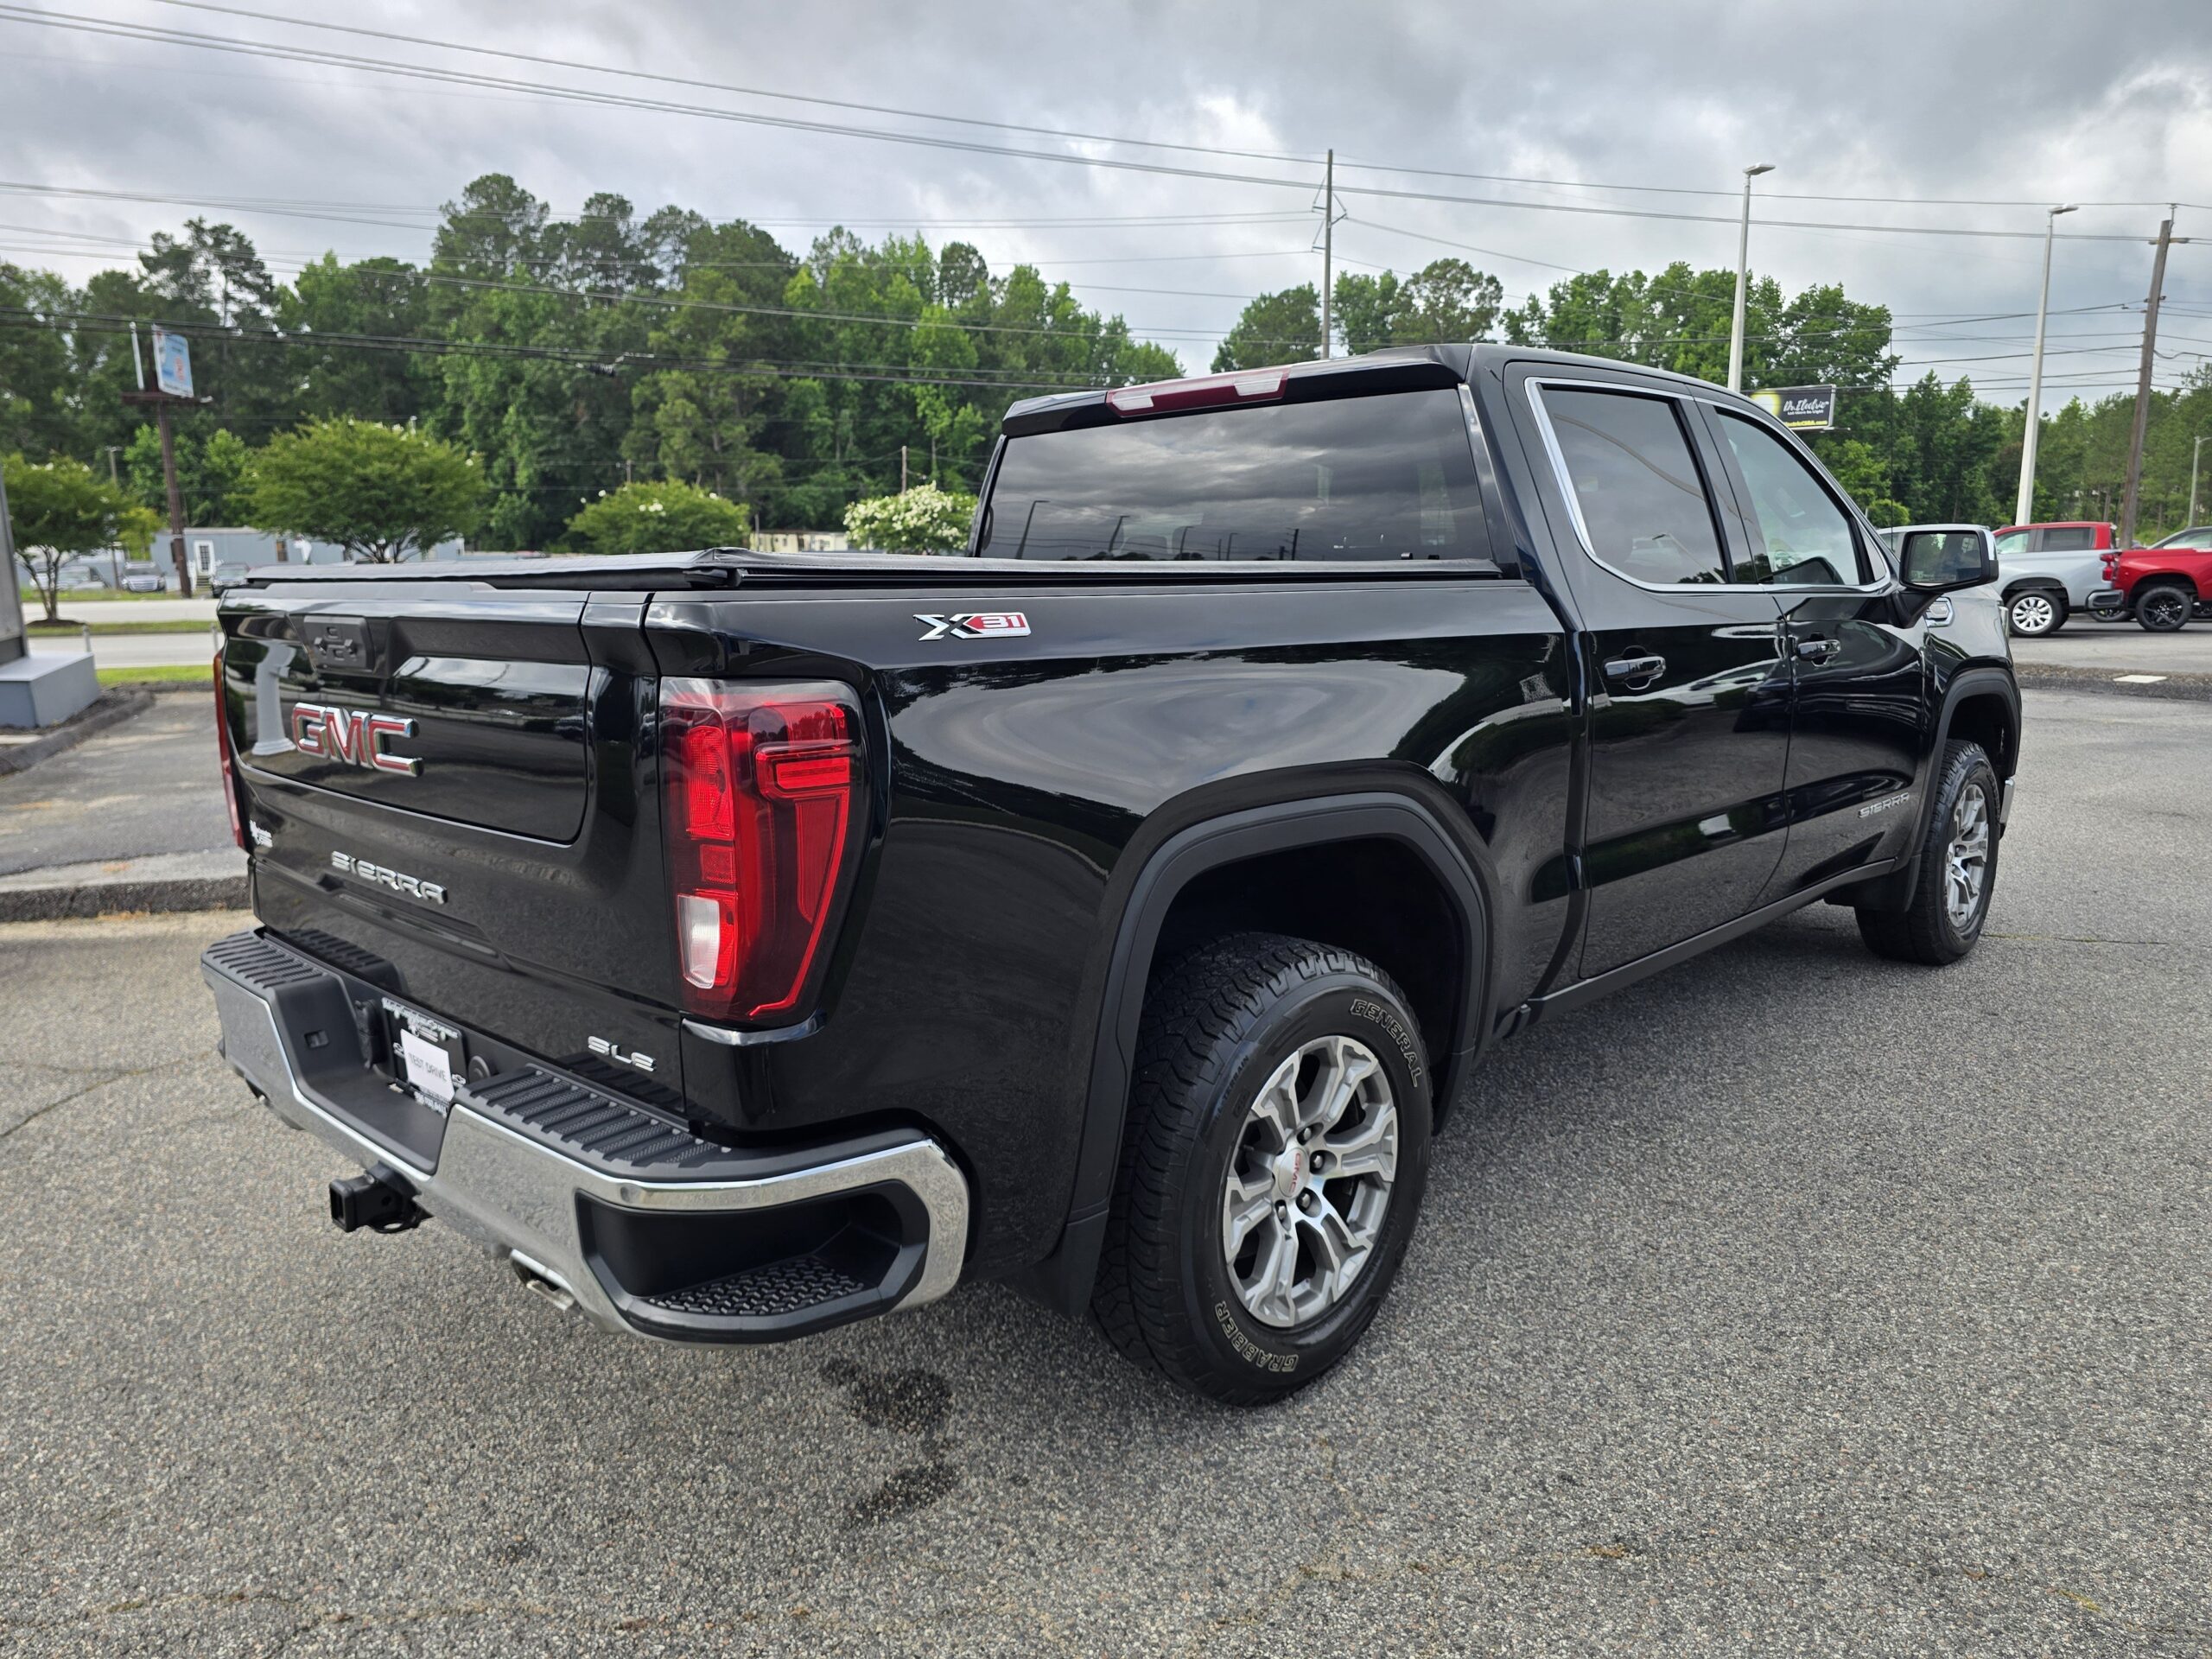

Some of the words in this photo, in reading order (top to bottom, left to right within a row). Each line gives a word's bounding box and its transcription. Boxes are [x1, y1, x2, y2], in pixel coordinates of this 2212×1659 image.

[912, 613, 1031, 641] X31
[291, 702, 423, 778] GMC
[1858, 791, 1910, 819] SIERRA
[331, 851, 448, 905] SIERRA
[588, 1036, 655, 1071] SLE
[1350, 999, 1422, 1088] GENERAL
[409, 1052, 423, 1069] TEST
[424, 1062, 448, 1083] DRIVE
[1222, 1055, 1249, 1101] TERRAIN
[1287, 1153, 1301, 1192] GMC
[1215, 1300, 1299, 1372] GRABBER
